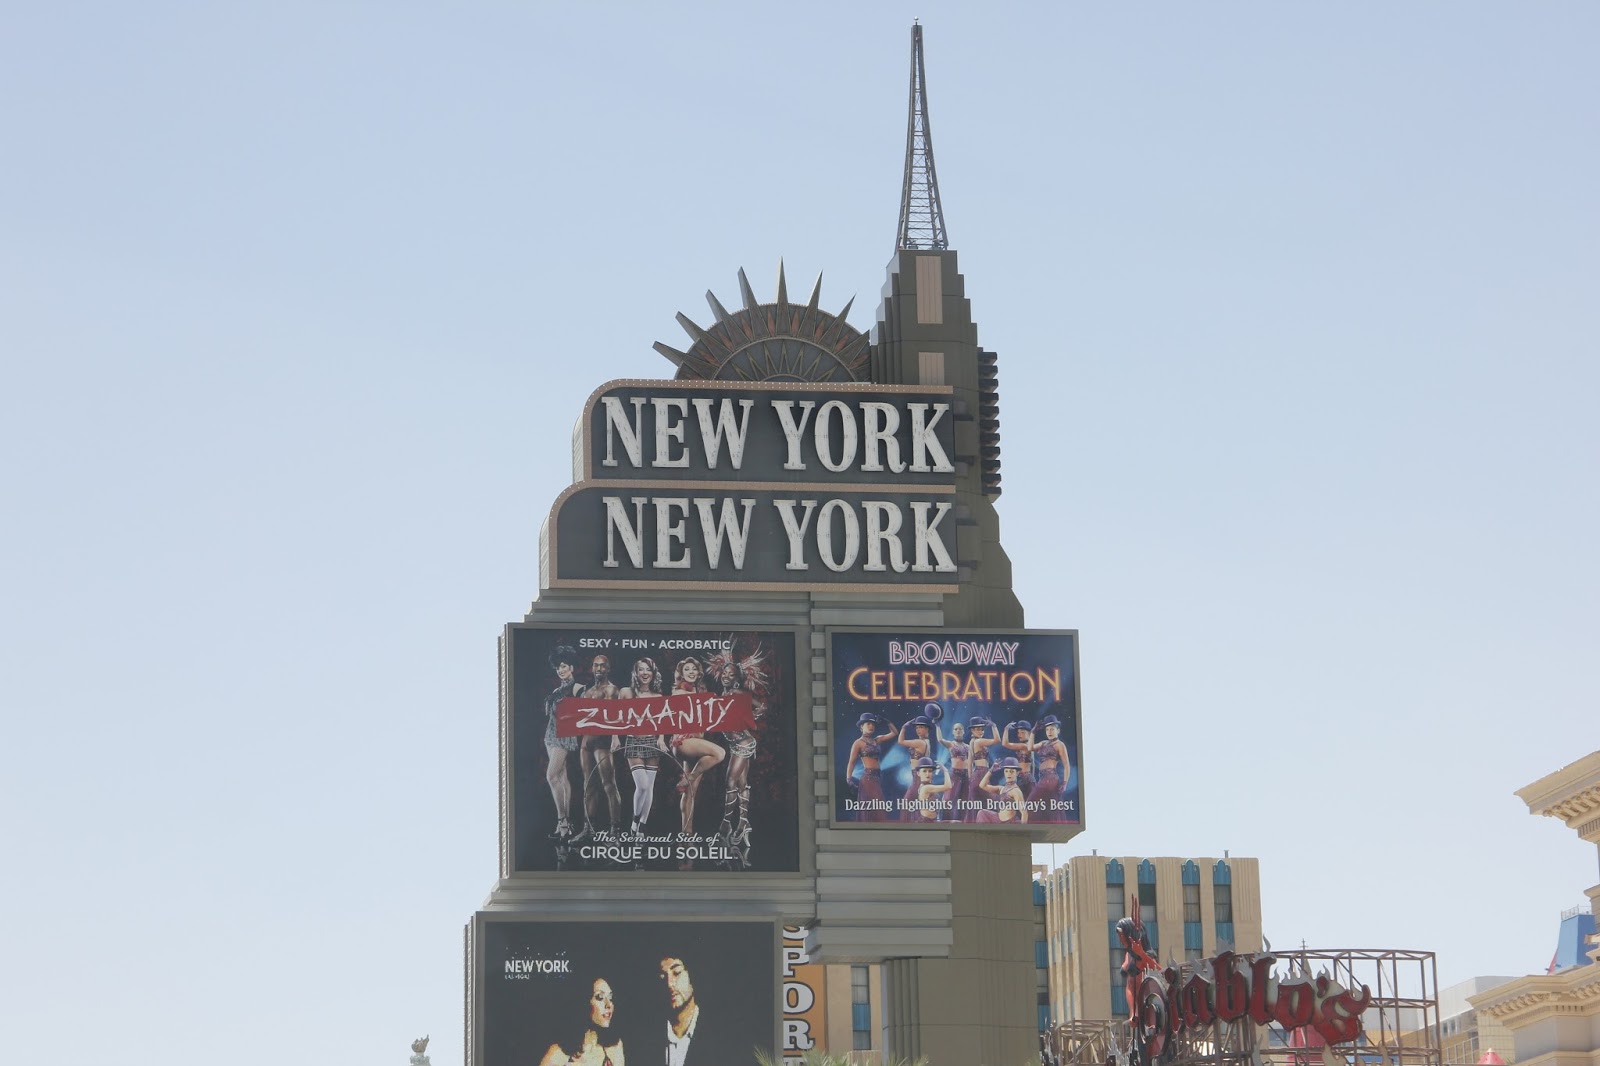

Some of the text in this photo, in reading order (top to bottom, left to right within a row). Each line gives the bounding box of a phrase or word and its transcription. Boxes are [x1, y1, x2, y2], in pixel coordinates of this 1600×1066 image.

[601, 396, 956, 474] NEW YORK
[602, 496, 958, 573] NEW YORK
[579, 638, 731, 650] SEXY FUN ACROBATIC
[889, 641, 1019, 666] BROADWAY
[845, 798, 1074, 812] Dazzling Highlights from Broadway's Best
[593, 831, 719, 848] The Sensual Side of
[580, 846, 732, 863] CIRQUE DU SOLEIL
[505, 960, 569, 974] NEW YORK
[783, 925, 815, 1066] POR
